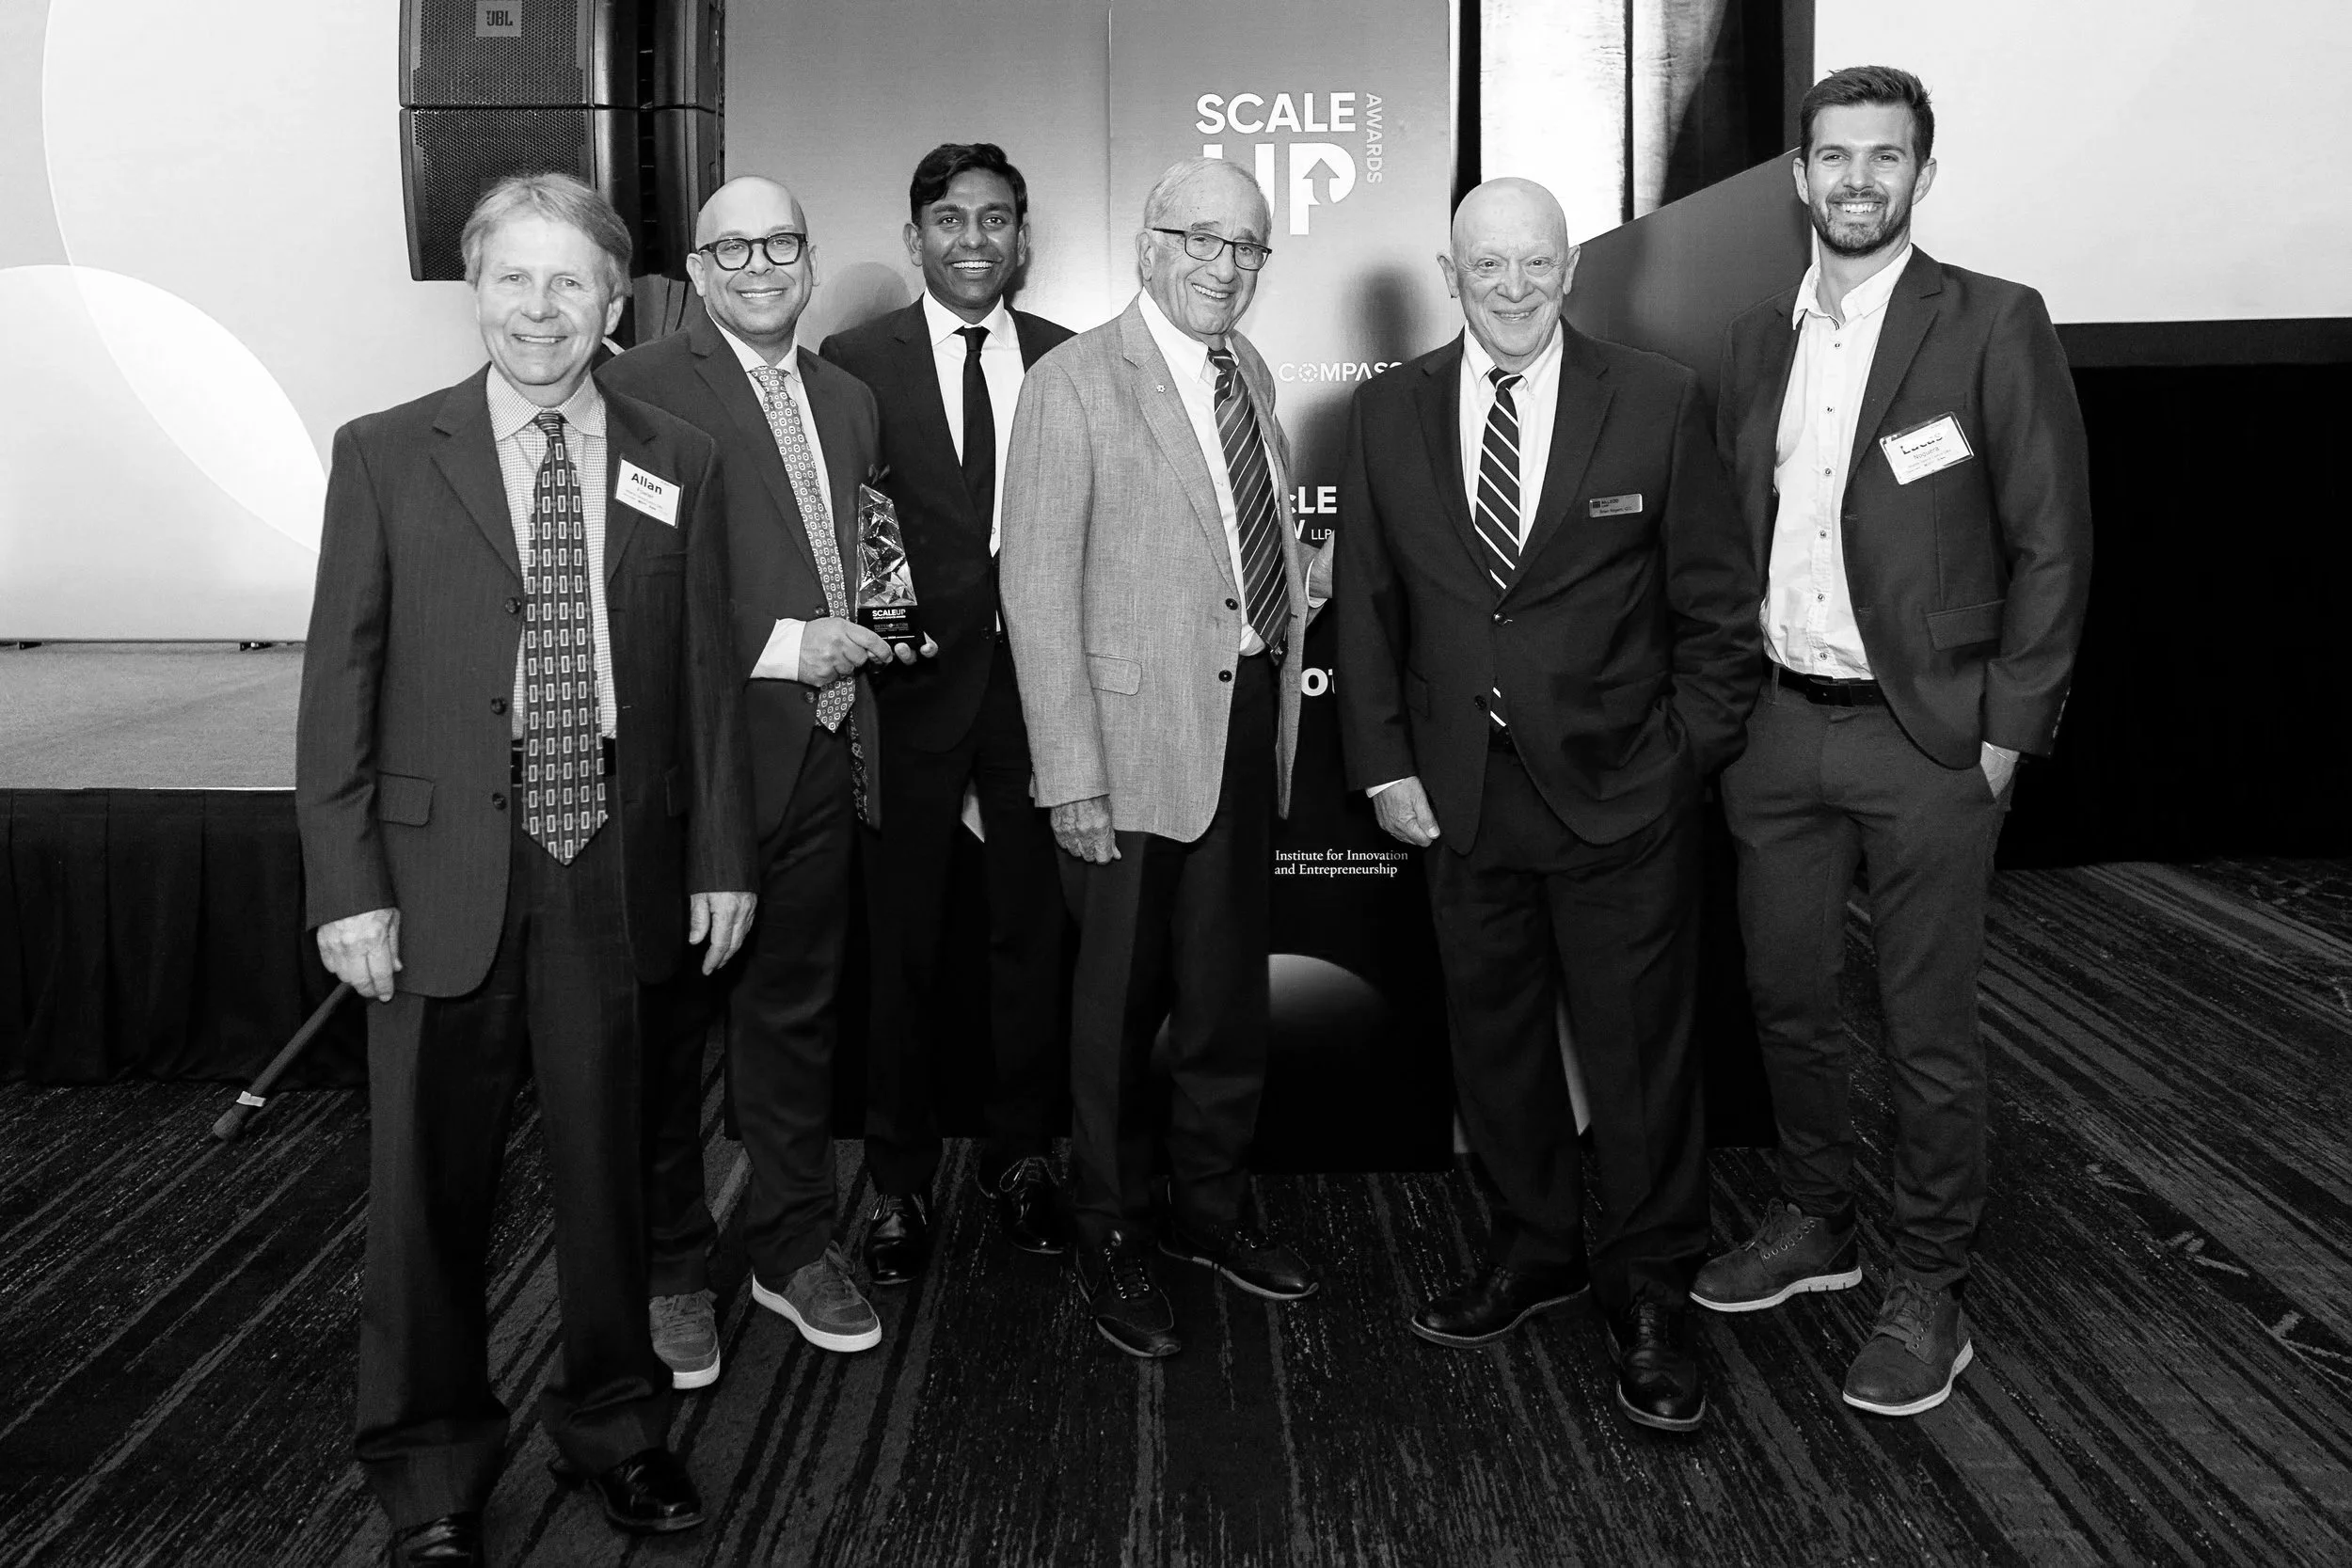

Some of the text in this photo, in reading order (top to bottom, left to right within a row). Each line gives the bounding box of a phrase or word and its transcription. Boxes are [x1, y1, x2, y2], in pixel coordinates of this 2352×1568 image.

[485, 10, 514, 26] JBL
[1195, 92, 1357, 135] SCALE
[1365, 93, 1383, 184] AWARDS
[1279, 362, 1403, 382] COMPAS
[631, 473, 662, 495] Allan
[1290, 485, 1338, 514] LE
[1311, 529, 1332, 540] LLP
[1275, 848, 1408, 861] Institute for Innovation
[1274, 863, 1398, 878] and Entrepreneurship
